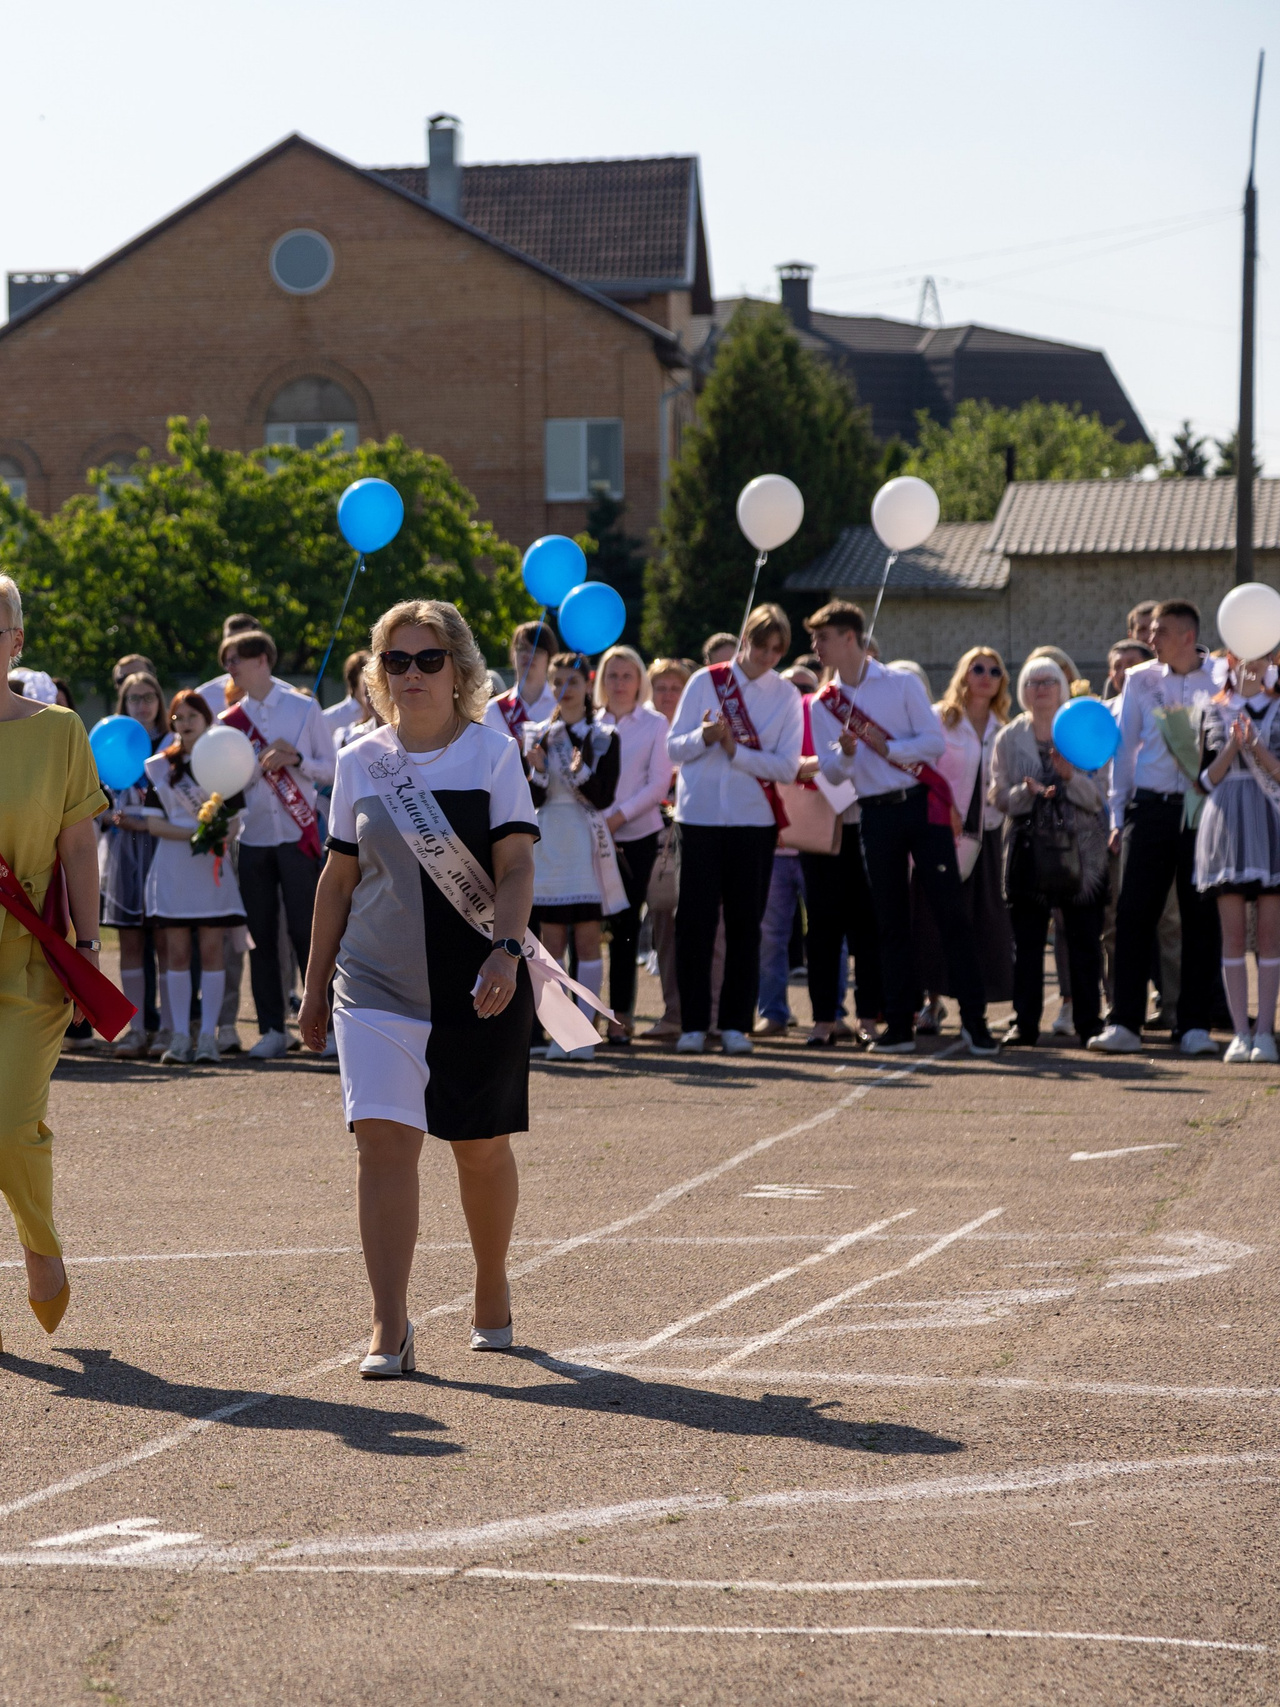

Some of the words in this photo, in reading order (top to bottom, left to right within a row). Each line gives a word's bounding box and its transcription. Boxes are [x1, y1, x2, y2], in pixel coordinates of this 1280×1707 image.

[391, 775, 445, 859] Классная
[447, 869, 488, 916] мама
[418, 789, 439, 825] Воробьёва
[439, 829, 460, 855] Жанна
[460, 857, 496, 903] Александровн
